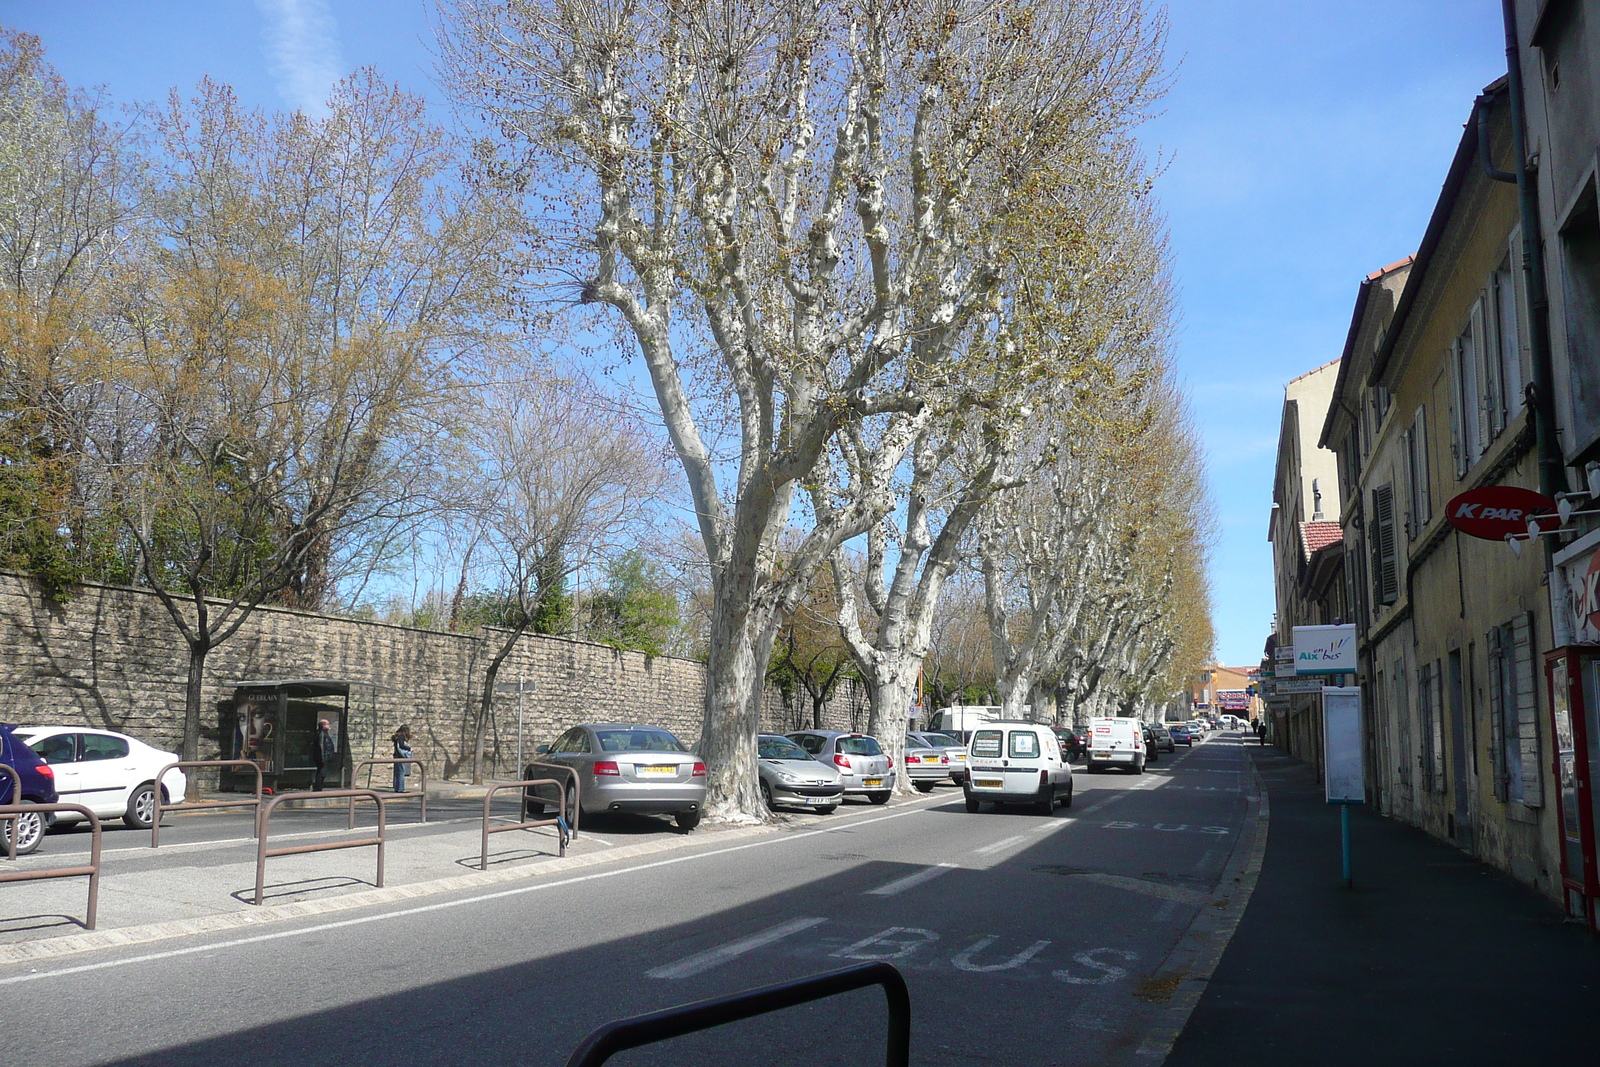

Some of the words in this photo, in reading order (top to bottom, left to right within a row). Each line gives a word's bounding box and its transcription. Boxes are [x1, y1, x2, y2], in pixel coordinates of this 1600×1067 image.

[1454, 502, 1482, 519] K
[1299, 651, 1318, 661] Aix
[1322, 649, 1342, 660] bus
[1220, 691, 1250, 701] Speedy
[263, 722, 274, 741] 2
[1101, 820, 1230, 835] BUS
[828, 926, 1138, 986] BUS
